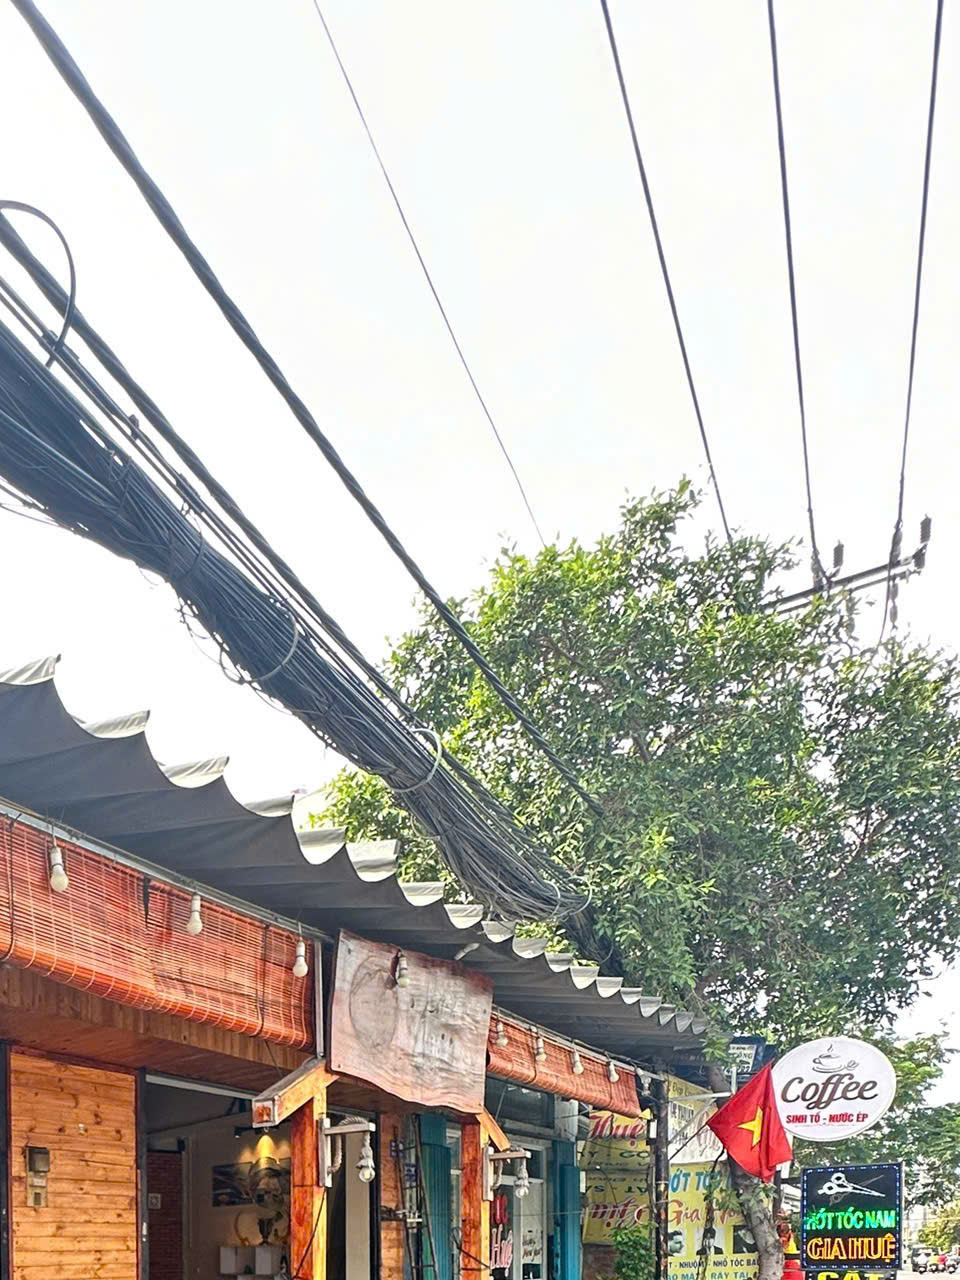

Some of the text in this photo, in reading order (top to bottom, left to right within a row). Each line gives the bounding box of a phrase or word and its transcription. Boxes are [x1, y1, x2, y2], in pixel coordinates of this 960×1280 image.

[781, 1073, 878, 1110] Coffee
[786, 1115, 807, 1124] SINH
[829, 1112, 854, 1123] NƯỚC
[856, 1111, 869, 1123] ÉP
[669, 1168, 692, 1193] ỚT
[836, 1206, 864, 1229] TÓC
[865, 1210, 896, 1229] NAM
[807, 1232, 896, 1263] GIA HUỆ
